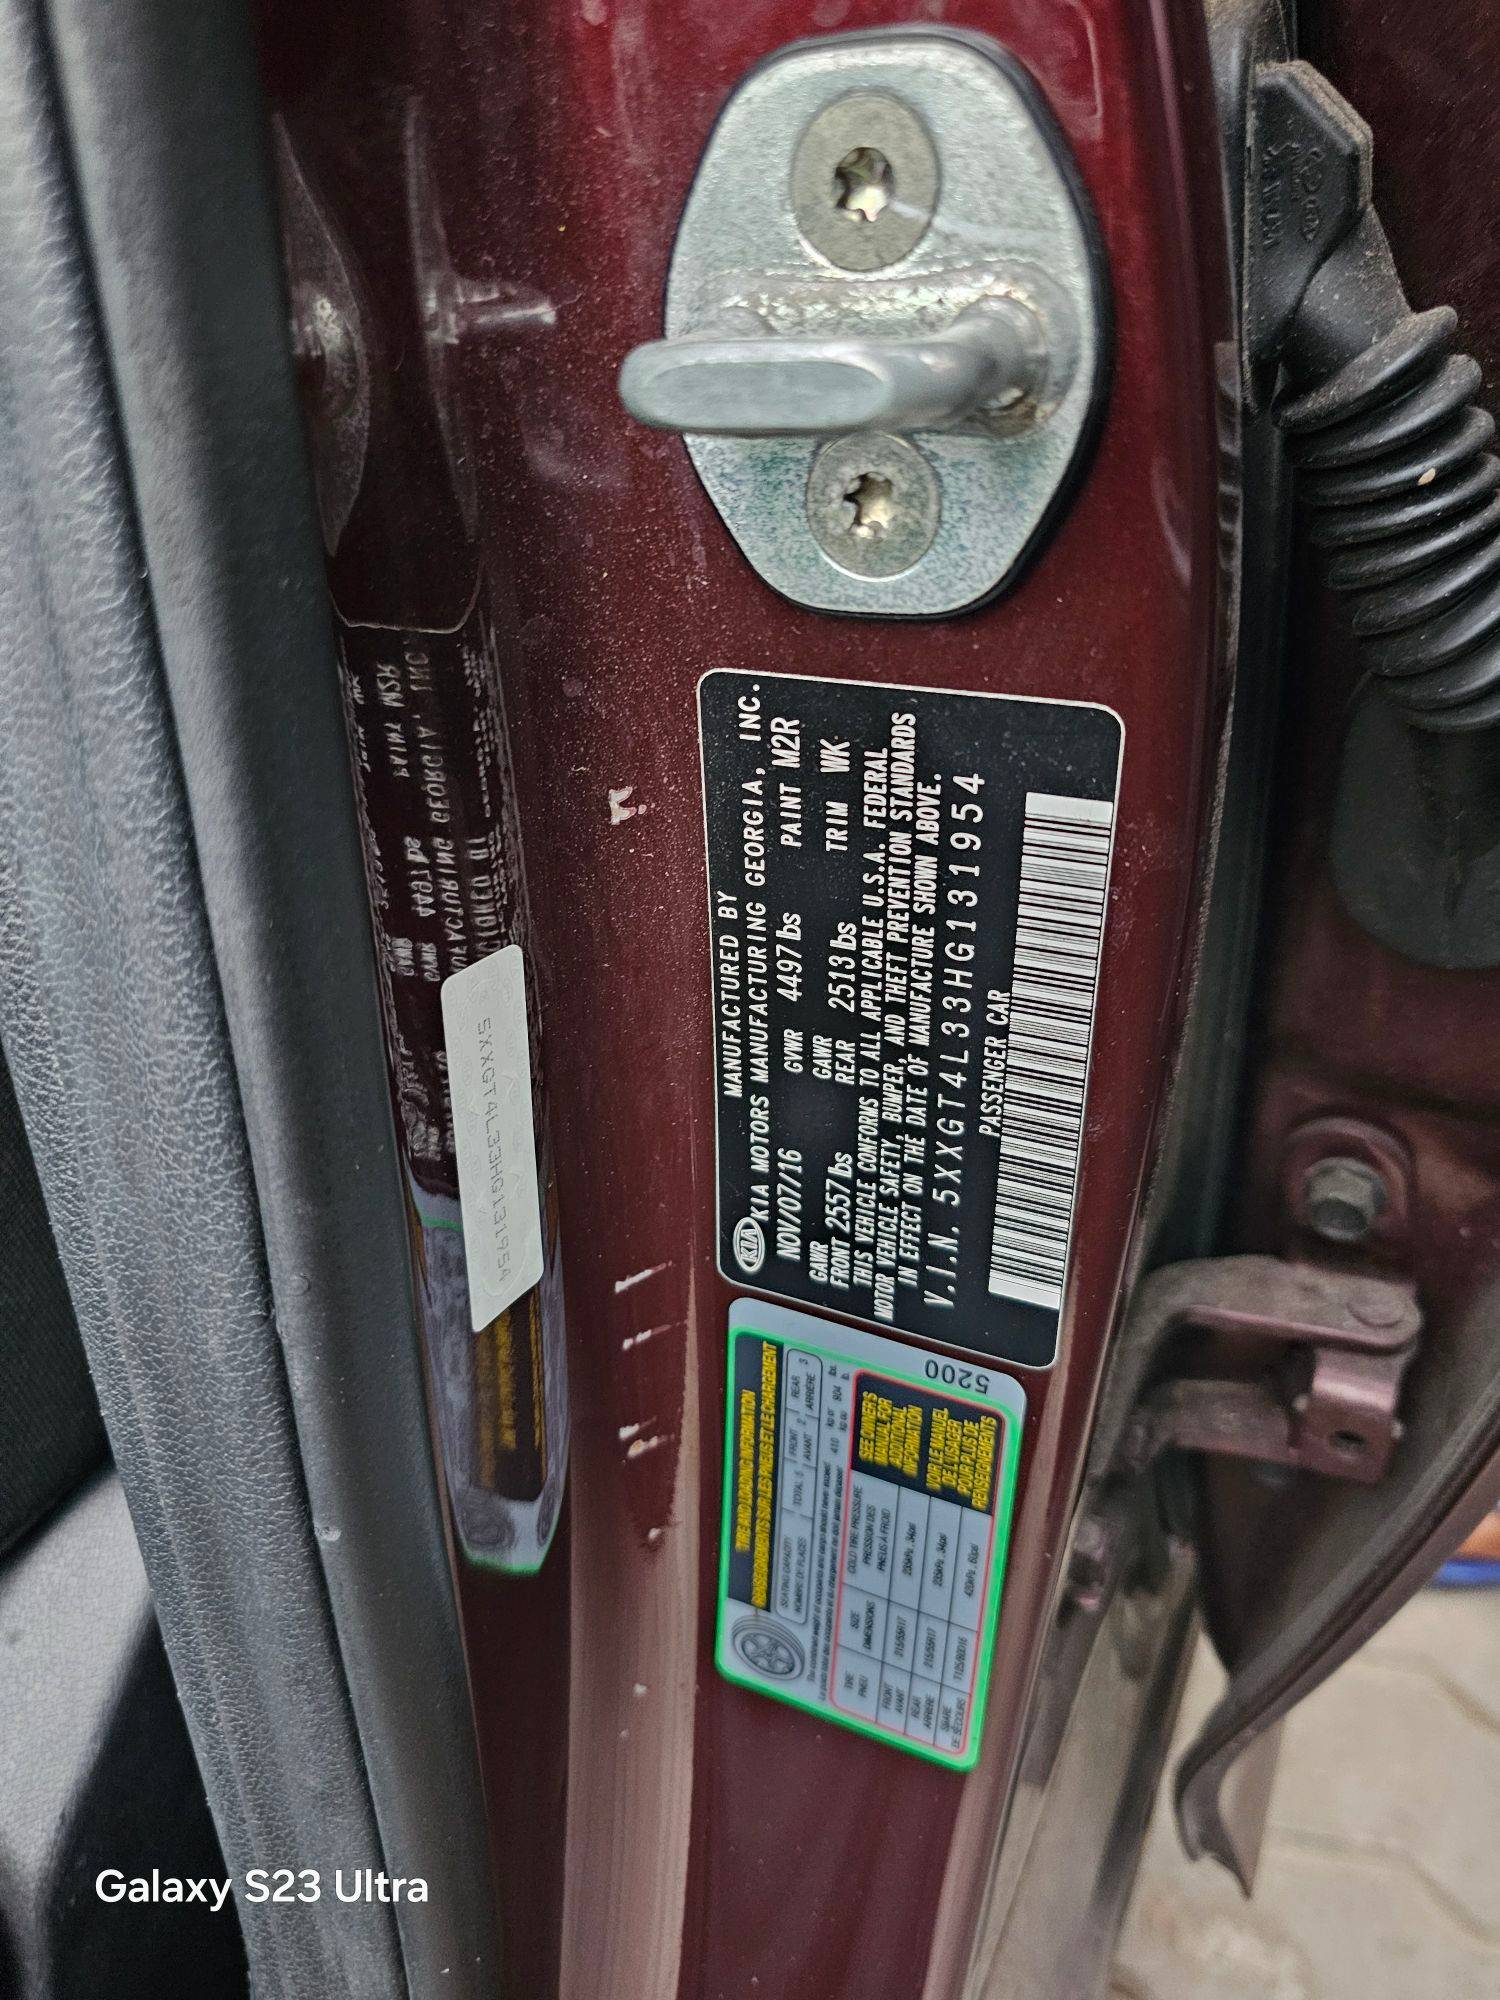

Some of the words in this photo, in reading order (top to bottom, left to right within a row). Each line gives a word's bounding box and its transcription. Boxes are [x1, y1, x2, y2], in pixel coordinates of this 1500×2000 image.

[737, 684, 762, 741] INC.
[770, 717, 801, 768] M2R
[820, 739, 850, 773] WK
[889, 712, 916, 821] STANDARDS
[863, 747, 888, 829] FEDERAL
[915, 773, 942, 845] ABOVE.
[742, 767, 765, 886] GEORGIA,
[780, 782, 802, 848] PAINT
[826, 800, 849, 852] TRIM
[862, 843, 886, 907] U.S.A.
[886, 831, 912, 944] PREVENTION
[912, 855, 938, 914] SHOWN
[717, 890, 738, 919] BY
[775, 912, 802, 940] lbs
[830, 921, 857, 950] lbs
[775, 944, 802, 1001] 4497
[828, 955, 856, 1012] 2513
[860, 916, 884, 1022] APPLICABLE
[885, 952, 908, 1004] THEFT
[908, 924, 935, 1046] MANUFACTURE
[746, 902, 769, 1083] MANUFACTURING
[932, 773, 985, 1208] 5XXGT4L33HG131954
[986, 990, 1010, 1025] CAR
[719, 934, 742, 1098] MANUFACTURED
[884, 1014, 906, 1046] AND
[783, 1028, 803, 1073] GVWR
[812, 1034, 832, 1079] GAWR
[835, 1039, 856, 1085] REAR
[860, 1032, 881, 1062] ALL
[907, 1053, 929, 1076] OF
[858, 1068, 880, 1087] TO
[881, 1058, 907, 1123] BUMPER,
[979, 1036, 1007, 1137] PASSENGER
[904, 1084, 928, 1127] DATE
[476, 1017, 513, 1283] 5XXGT4L33HG131954
[750, 1094, 770, 1173] MOTORS
[857, 1096, 879, 1172] CONFORMS
[904, 1134, 925, 1165] THE
[828, 1151, 852, 1178] lbs
[880, 1134, 904, 1198] SAFETY,
[902, 1172, 924, 1194] ON
[750, 1184, 769, 1221] KIA
[777, 1148, 802, 1260] NOV/07/16
[825, 1179, 850, 1234] 2557
[855, 1178, 876, 1242] VEHICLE
[741, 1227, 758, 1262] KIA
[876, 1202, 898, 1268] VEHICLE
[899, 1201, 922, 1262] EFFECT
[809, 1240, 828, 1282] GAWR
[830, 1236, 850, 1289] FRONT
[853, 1250, 874, 1288] THIS
[898, 1265, 918, 1288] IN
[924, 1226, 961, 1309] V.I.N.
[874, 1272, 895, 1321] MOTOR
[761, 1340, 777, 1414] CHARGEMENT
[791, 1375, 800, 1399] REAR
[925, 1359, 989, 1394] 5200
[740, 1389, 756, 1457] INFORMATION
[761, 1413, 775, 1430] LE
[877, 1397, 892, 1421] FOR
[930, 1408, 948, 1450] MANUEL
[964, 1419, 978, 1437] DE
[760, 1427, 775, 1444] ET
[788, 1428, 798, 1456] FRONT
[803, 1432, 812, 1461] AVANT
[859, 1438, 874, 1462] SEE
[874, 1421, 890, 1466] MANUAL
[888, 1406, 907, 1470] ADDITIONAL
[902, 1404, 923, 1478] INFORMATION
[928, 1448, 943, 1463] LE
[960, 1437, 977, 1463] PLUS
[738, 1458, 754, 1503] LOADING
[758, 1444, 774, 1476] PNEUS
[926, 1462, 942, 1492] VOIR
[941, 1468, 957, 1487] DE
[957, 1462, 974, 1497] POUR
[972, 1415, 997, 1511] RENSEIGNEMENTS
[756, 1497, 771, 1520] SUR
[758, 1477, 773, 1498] LES
[793, 1482, 801, 1505] TOTAL
[850, 1484, 862, 1529] PRESSURE
[737, 1504, 752, 1525] AND
[866, 1505, 876, 1522] DES
[878, 1508, 890, 1534] FROID
[735, 1526, 750, 1552] TIRE
[849, 1532, 858, 1549] TIRE
[862, 1523, 874, 1564] PRESSION
[876, 1543, 888, 1572] PNEUS
[751, 1520, 770, 1608] RENSEIGNEMENTS
[847, 1551, 856, 1574] COLD
[850, 1610, 860, 1630] SIZE
[862, 1600, 876, 1650] DIMENSIONS
[845, 1670, 854, 1689] TIRE
[858, 1675, 868, 1698] PNEU
[883, 1682, 893, 1710] FRONT
[911, 1695, 921, 1719] REAR
